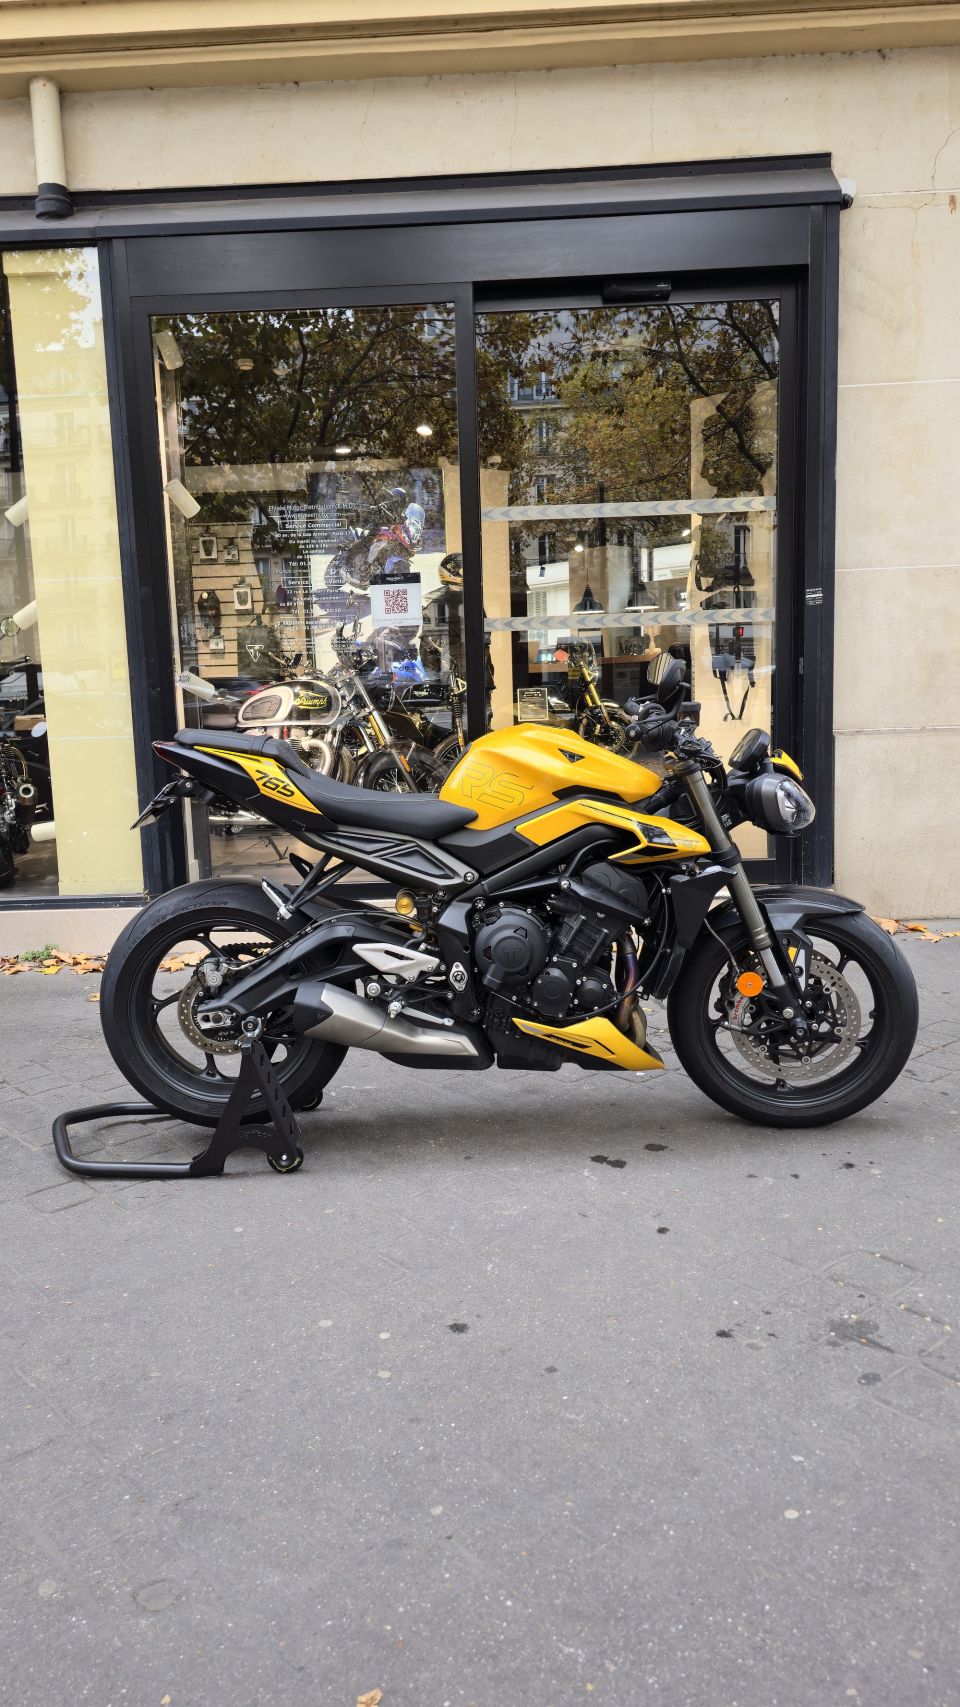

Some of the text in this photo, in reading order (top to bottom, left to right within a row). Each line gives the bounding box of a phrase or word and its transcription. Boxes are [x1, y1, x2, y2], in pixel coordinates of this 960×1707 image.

[294, 690, 328, 709] Triumph
[255, 769, 295, 798] 765
[462, 760, 535, 810] RS
[732, 996, 744, 1020] brembo
